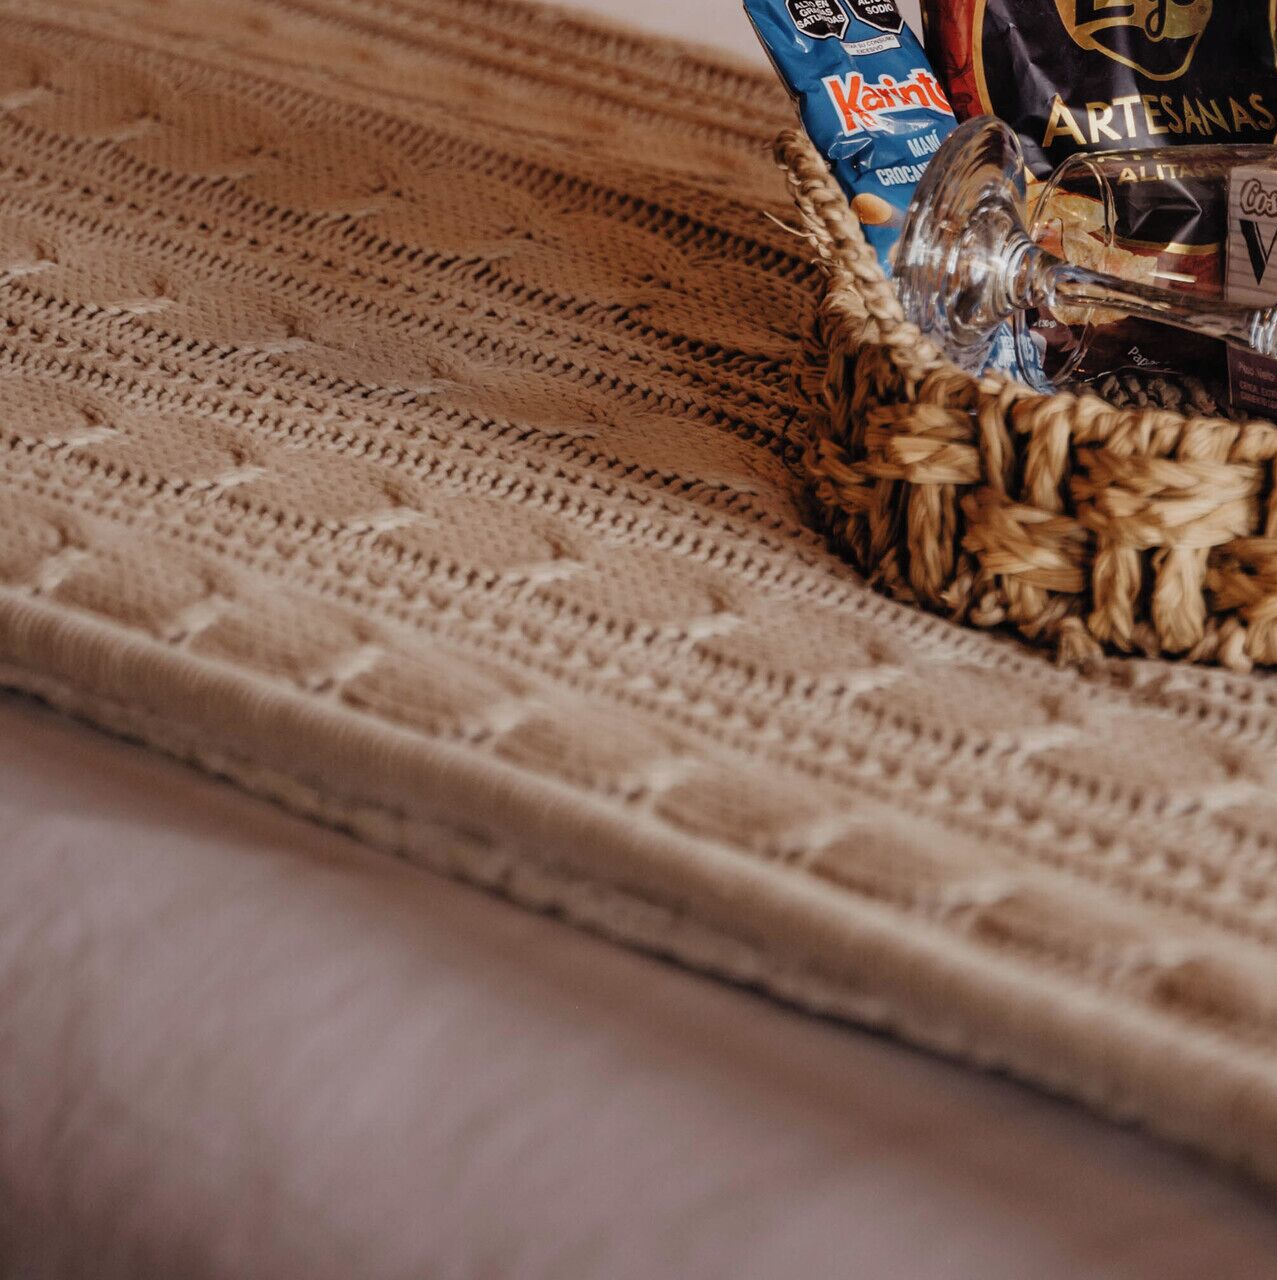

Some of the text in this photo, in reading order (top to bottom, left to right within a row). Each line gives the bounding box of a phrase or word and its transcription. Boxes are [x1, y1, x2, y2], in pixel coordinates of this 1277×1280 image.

[816, 0, 829, 9] EN
[864, 3, 894, 15] SODIO
[1042, 91, 1277, 147] ARTESANAS
[906, 128, 942, 158] MANÍ
